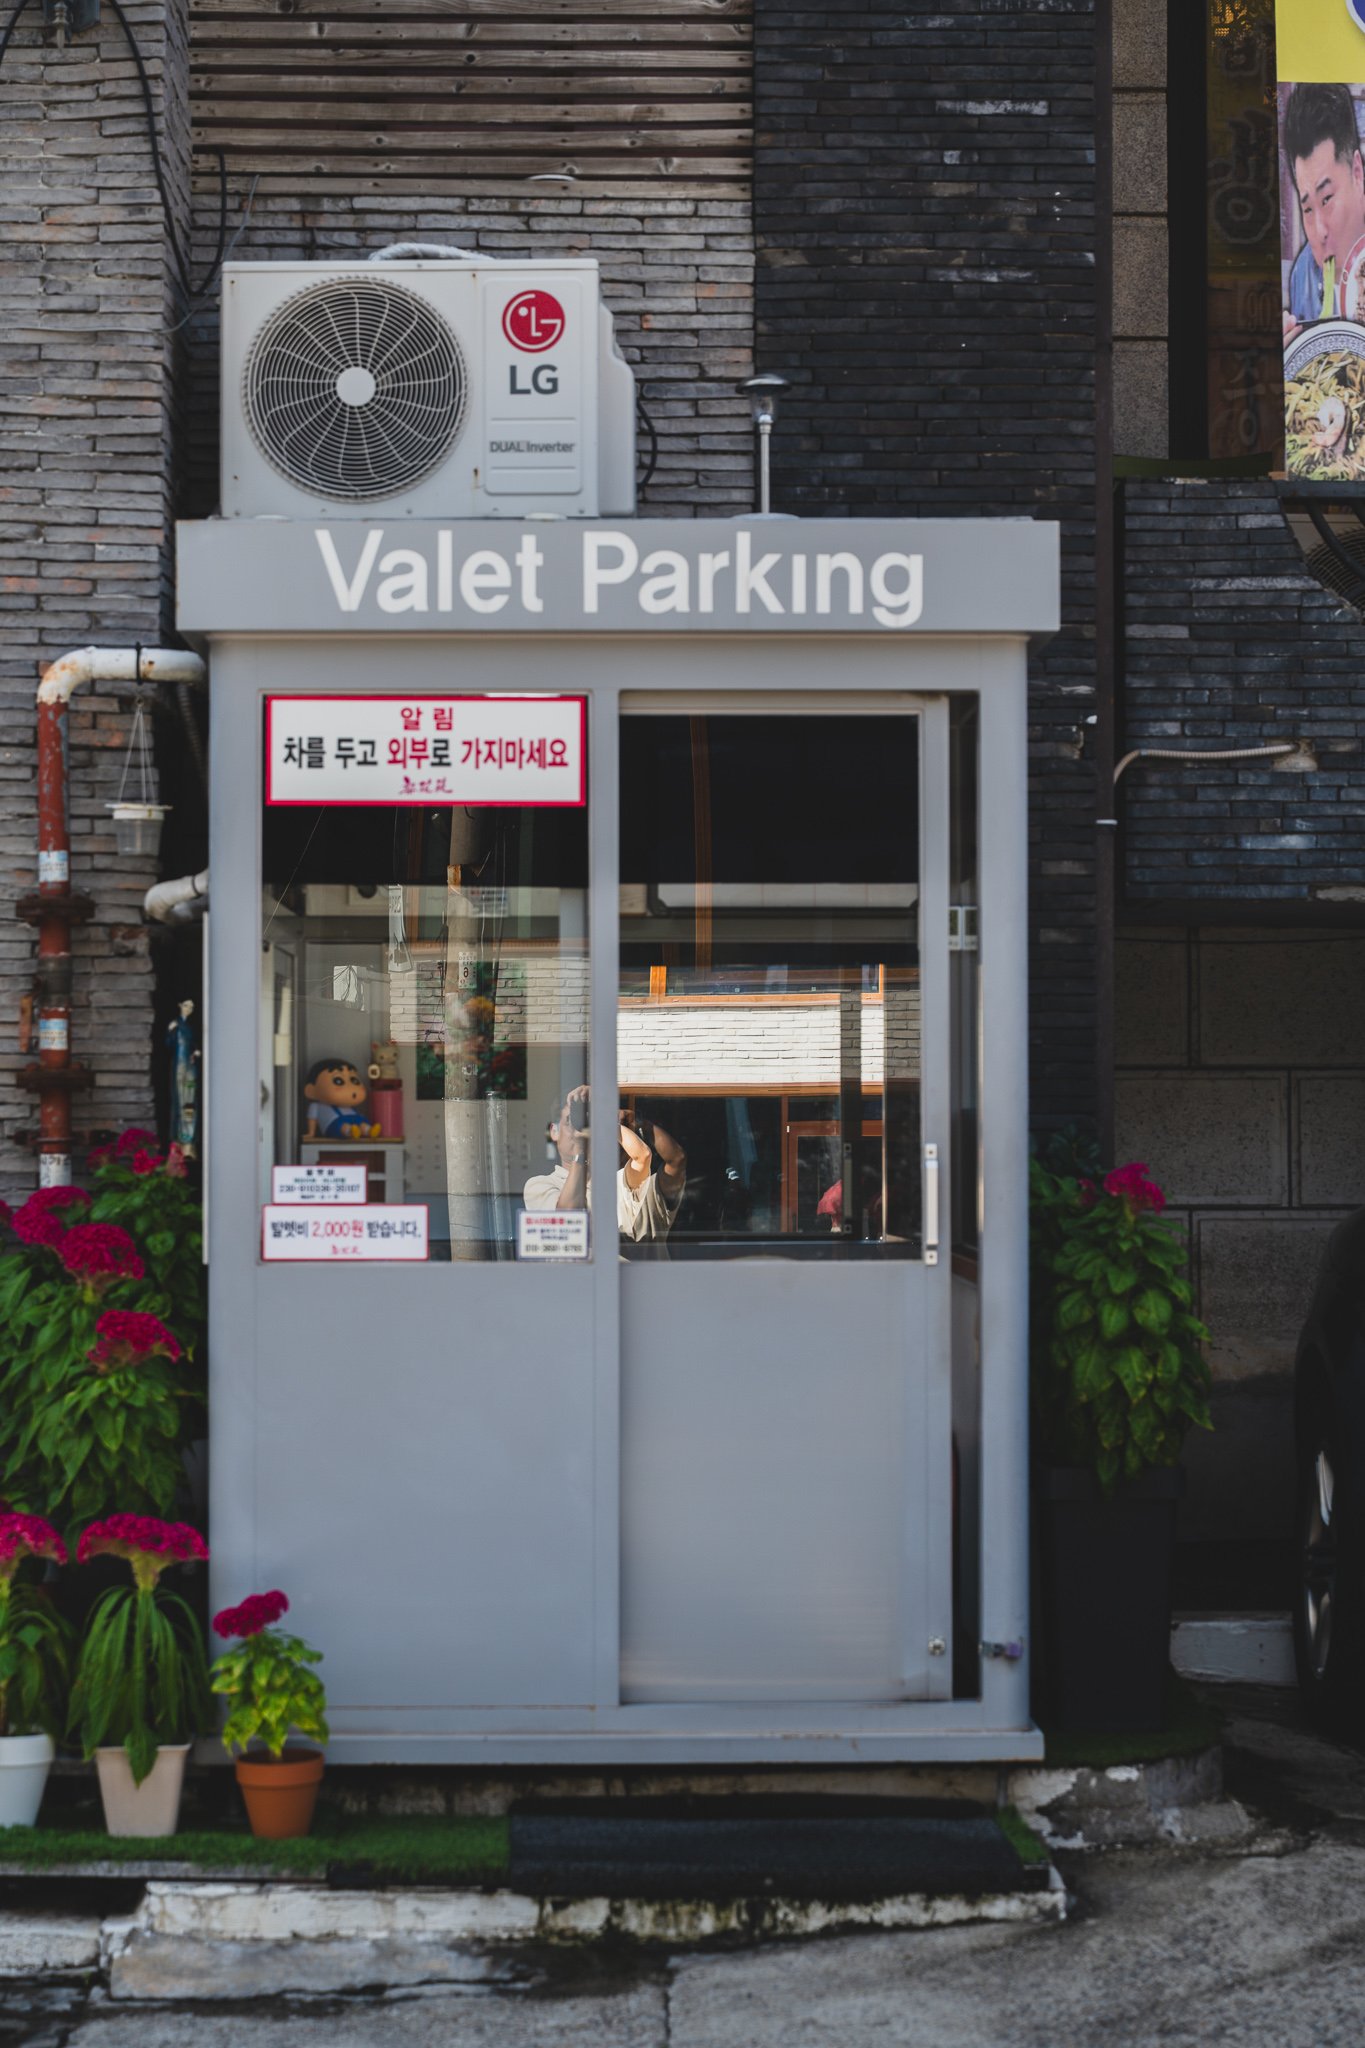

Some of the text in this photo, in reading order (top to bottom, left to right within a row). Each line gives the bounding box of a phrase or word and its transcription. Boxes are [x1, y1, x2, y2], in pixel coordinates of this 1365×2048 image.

[509, 364, 559, 395] LG
[489, 440, 574, 453] DUAL Inverter
[314, 529, 543, 614] Valet
[283, 736, 569, 769] 차를 두고 외부로 가지마세요
[312, 1220, 364, 1238] 2,000원
